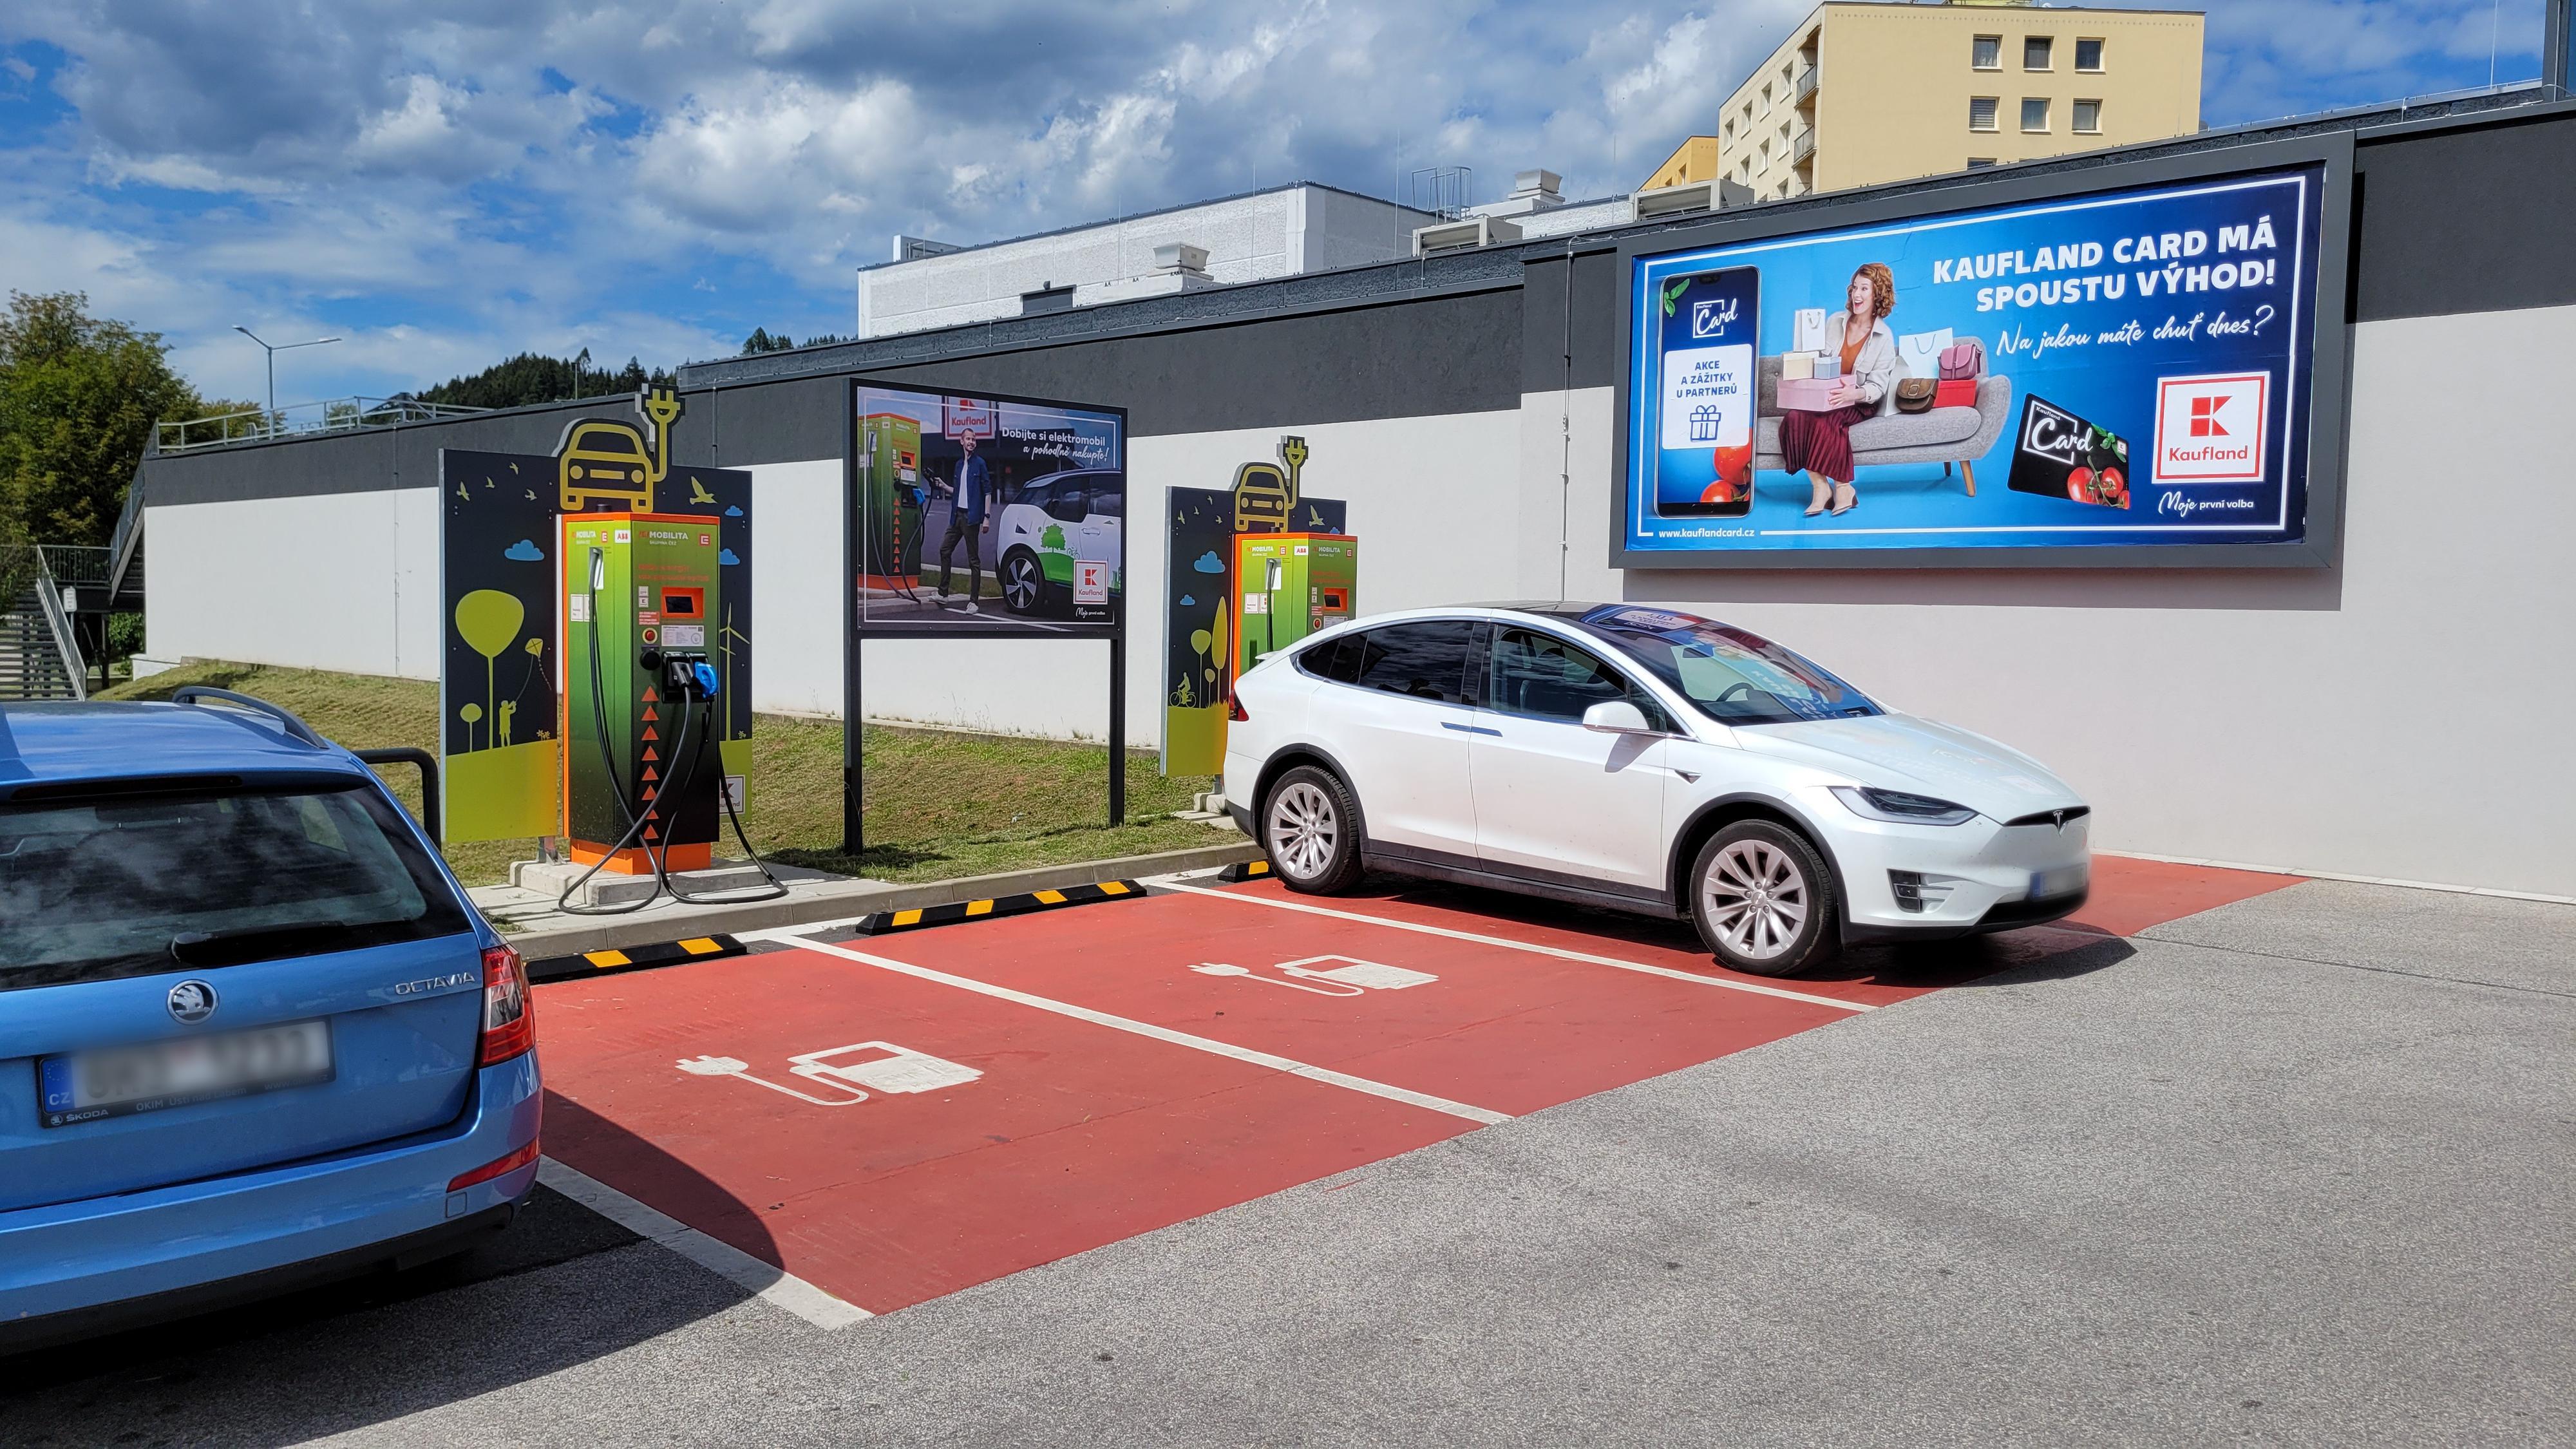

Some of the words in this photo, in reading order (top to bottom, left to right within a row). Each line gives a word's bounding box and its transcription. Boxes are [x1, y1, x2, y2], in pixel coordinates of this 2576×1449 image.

[1933, 242, 2103, 284] KAUFLAND
[2112, 231, 2207, 263] CARD
[2218, 215, 2277, 253] MÁ
[1976, 274, 2125, 312] SPOUSTU
[2136, 259, 2275, 297] VÝHOD!
[1696, 298, 1738, 335] Card
[1996, 321, 2033, 356] Na
[2032, 323, 2090, 359] jakou
[2097, 323, 2146, 346] máte
[2152, 311, 2205, 341] chuť
[2208, 305, 2274, 335] dnes?
[1694, 361, 1720, 371] AKCE
[1681, 376, 1688, 385] A
[1690, 372, 1733, 384] ZÁŽITKY
[1676, 390, 1683, 398] U
[1685, 383, 1737, 398] PARTNERŮ
[951, 415, 987, 426] Kaufland
[2035, 406, 2061, 421] Kaufland
[1001, 427, 1037, 441] Dobijte
[1039, 431, 1046, 440] si
[1048, 433, 1105, 446] elektromobil
[2031, 418, 2093, 453] Card
[1031, 442, 1070, 460] pohodlně
[2168, 445, 2248, 462] Kaufland
[2157, 491, 2197, 517] Moje
[2199, 499, 2225, 511] první
[2226, 498, 2254, 509] volba
[1658, 527, 1755, 538] www.kauflandcard.cz
[395, 972, 475, 995] OCTAVIA
[49, 1092, 70, 1106] CZ
[136, 1099, 164, 1112] OKIM
[66, 1108, 109, 1122] ŠKODA
